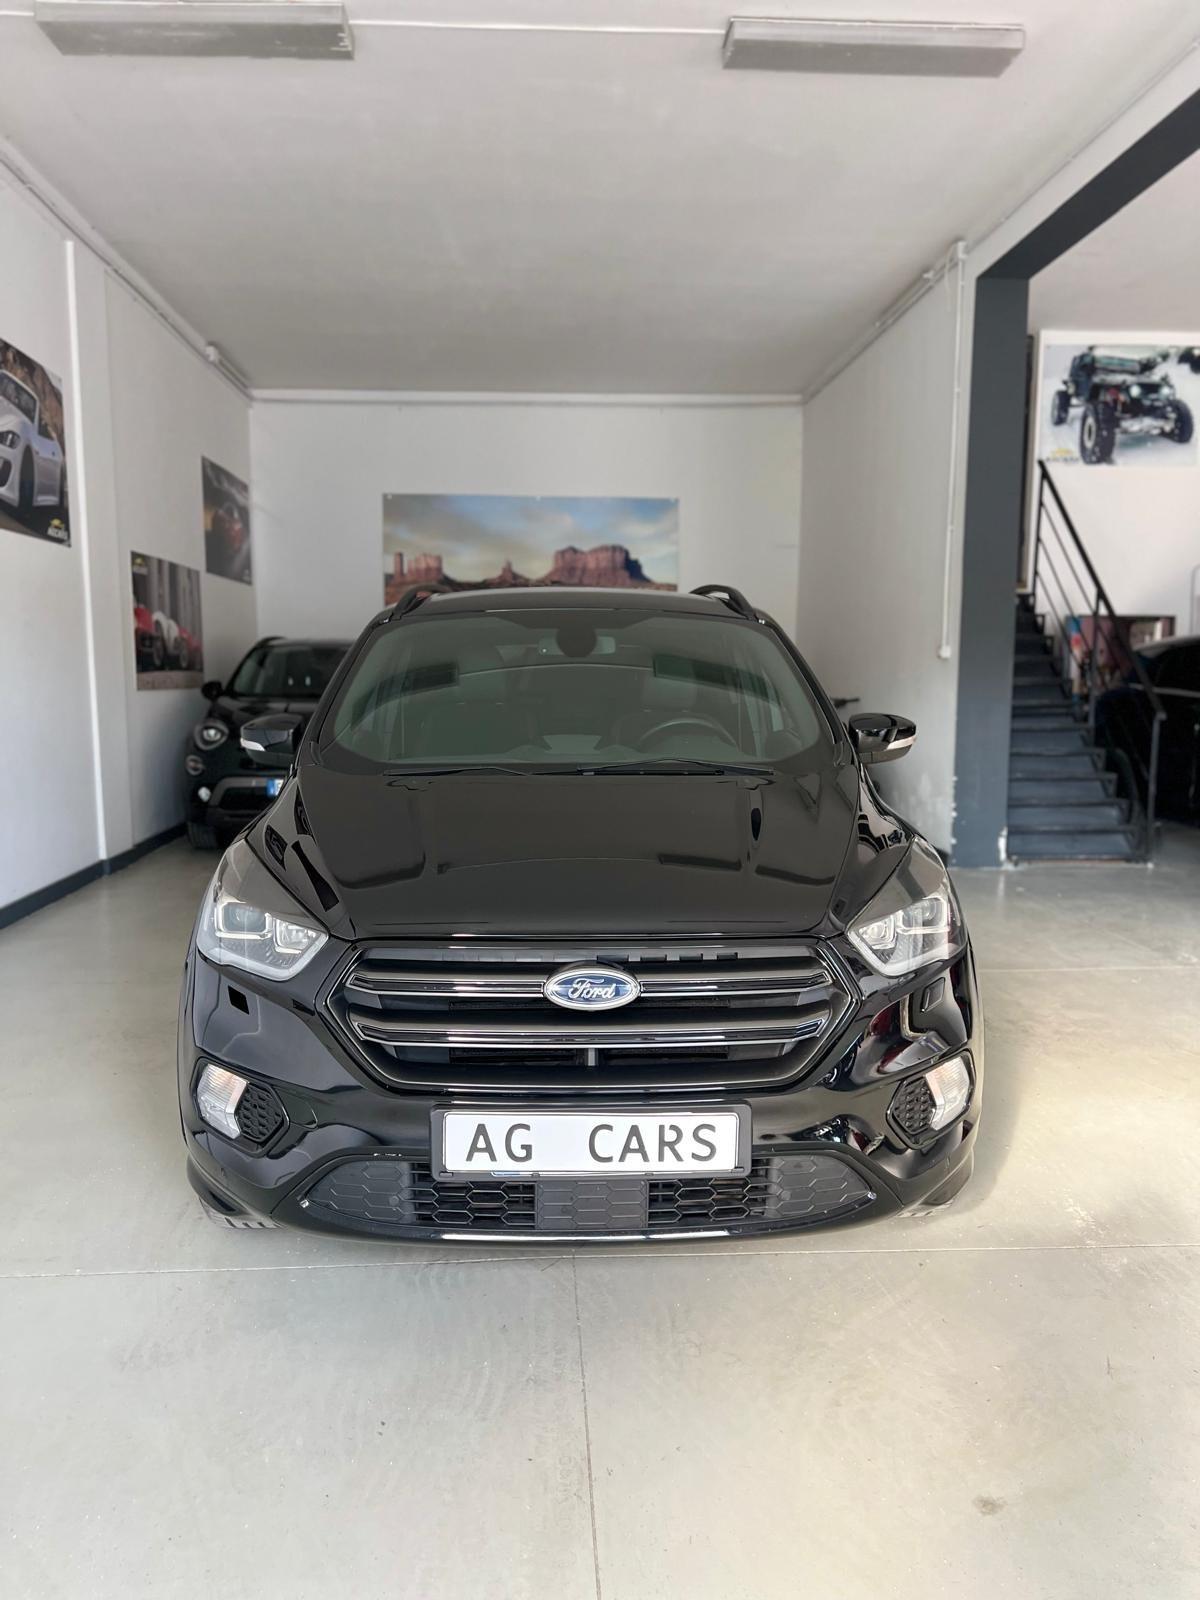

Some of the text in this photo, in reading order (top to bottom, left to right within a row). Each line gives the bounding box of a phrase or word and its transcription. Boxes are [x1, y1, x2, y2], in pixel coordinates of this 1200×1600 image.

[568, 978, 617, 999] Ford
[466, 1123, 717, 1163] AG CARS
